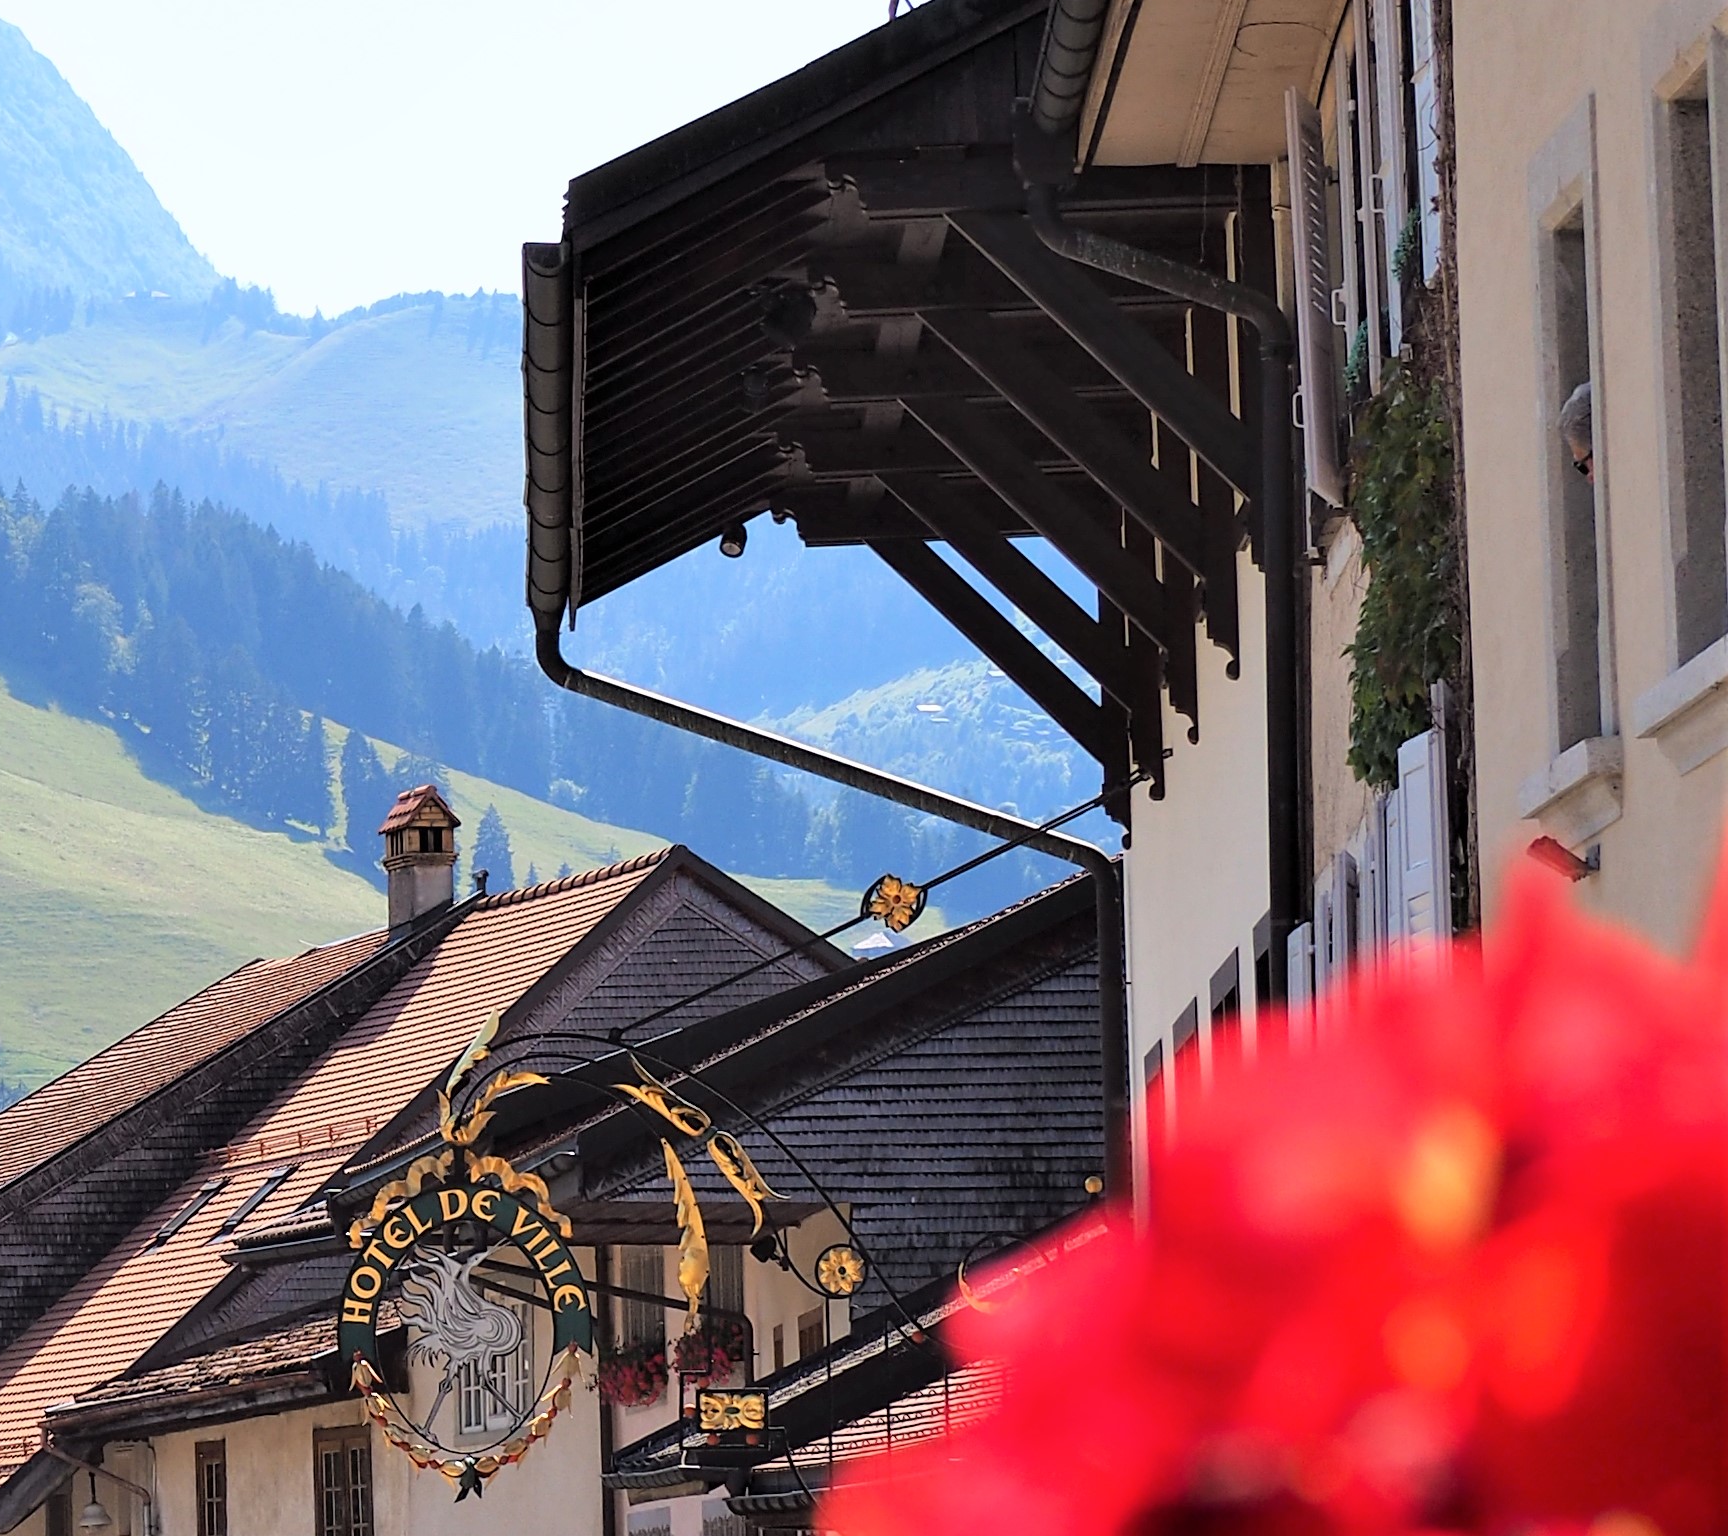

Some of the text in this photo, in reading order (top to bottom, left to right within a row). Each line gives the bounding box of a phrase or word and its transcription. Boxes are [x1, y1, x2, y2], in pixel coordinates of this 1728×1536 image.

[342, 1189, 587, 1325] HOTEL DE VILLE
